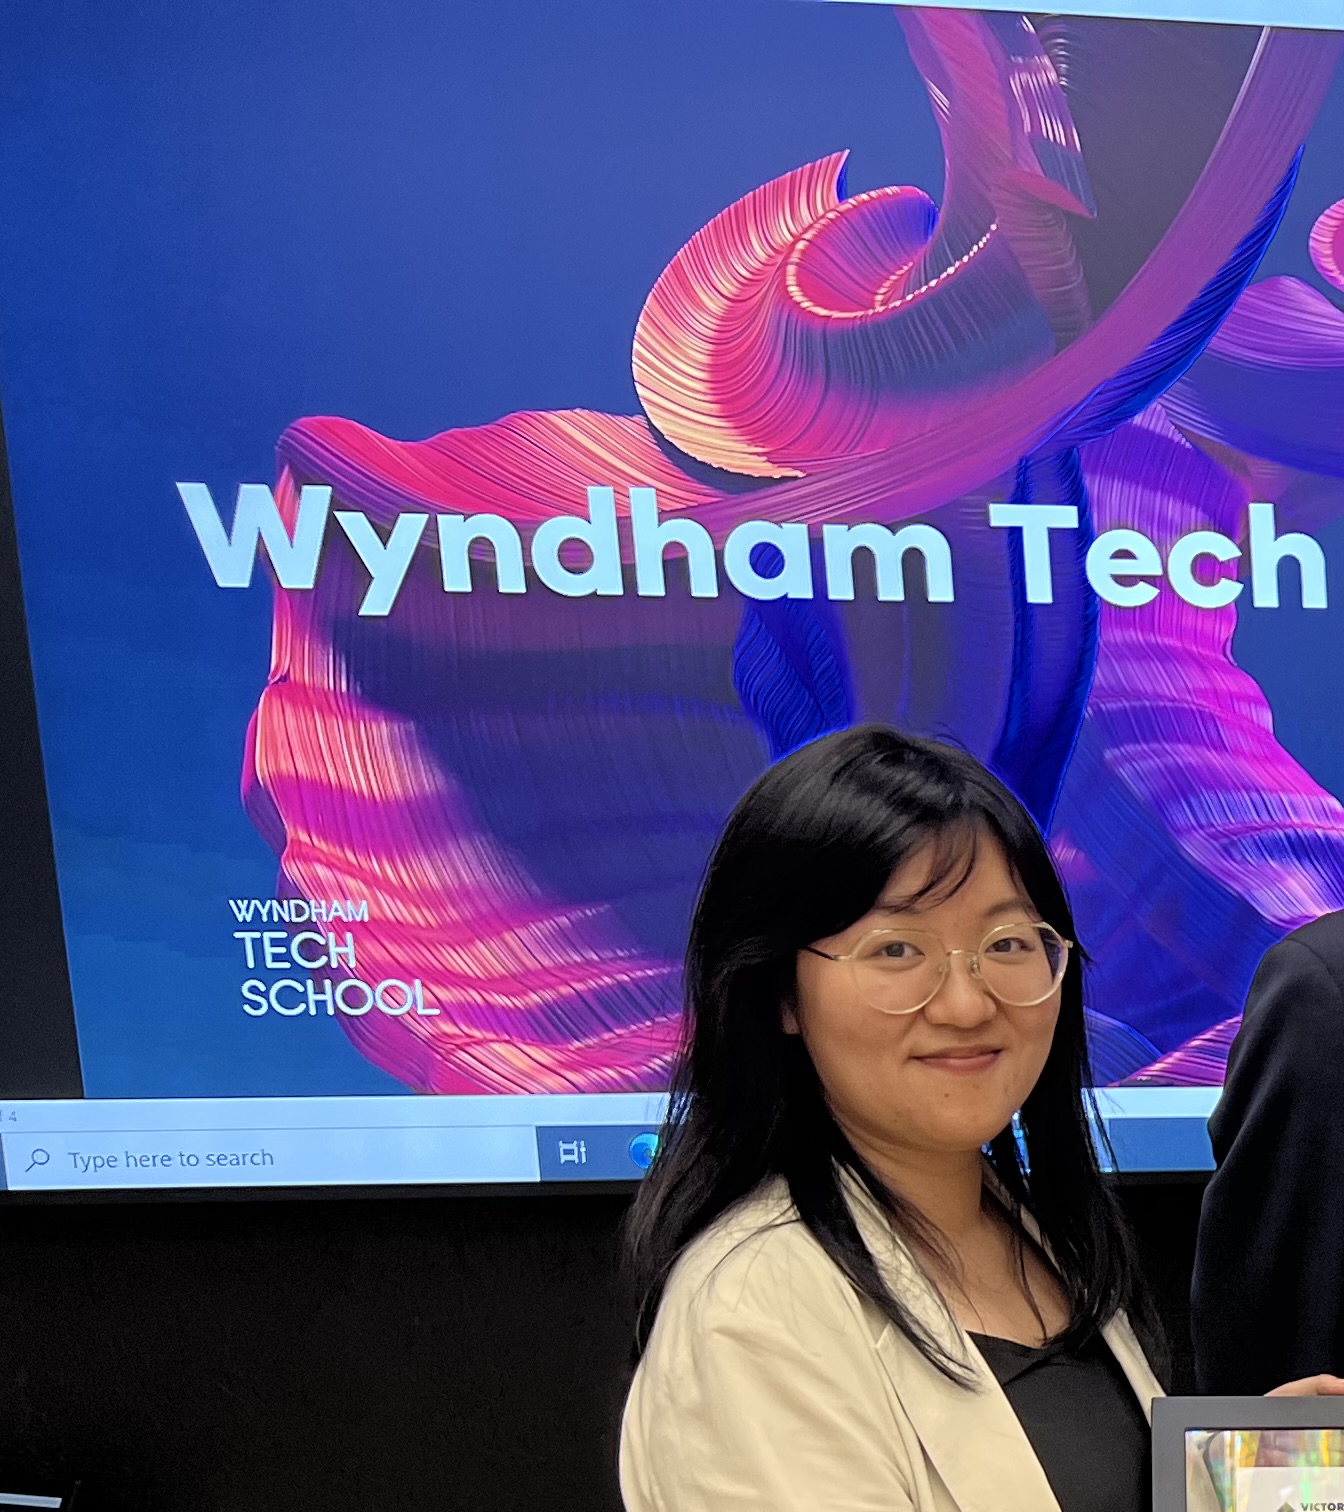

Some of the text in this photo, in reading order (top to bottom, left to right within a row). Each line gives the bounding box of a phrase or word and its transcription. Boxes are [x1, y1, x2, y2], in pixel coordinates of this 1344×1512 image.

[174, 481, 954, 616] Wyndham
[989, 503, 1327, 609] Tech
[228, 899, 369, 922] WYNDHAM
[233, 931, 356, 969] TECH
[241, 978, 440, 1017] SCHOOL
[68, 1149, 274, 1173] Type here to search
